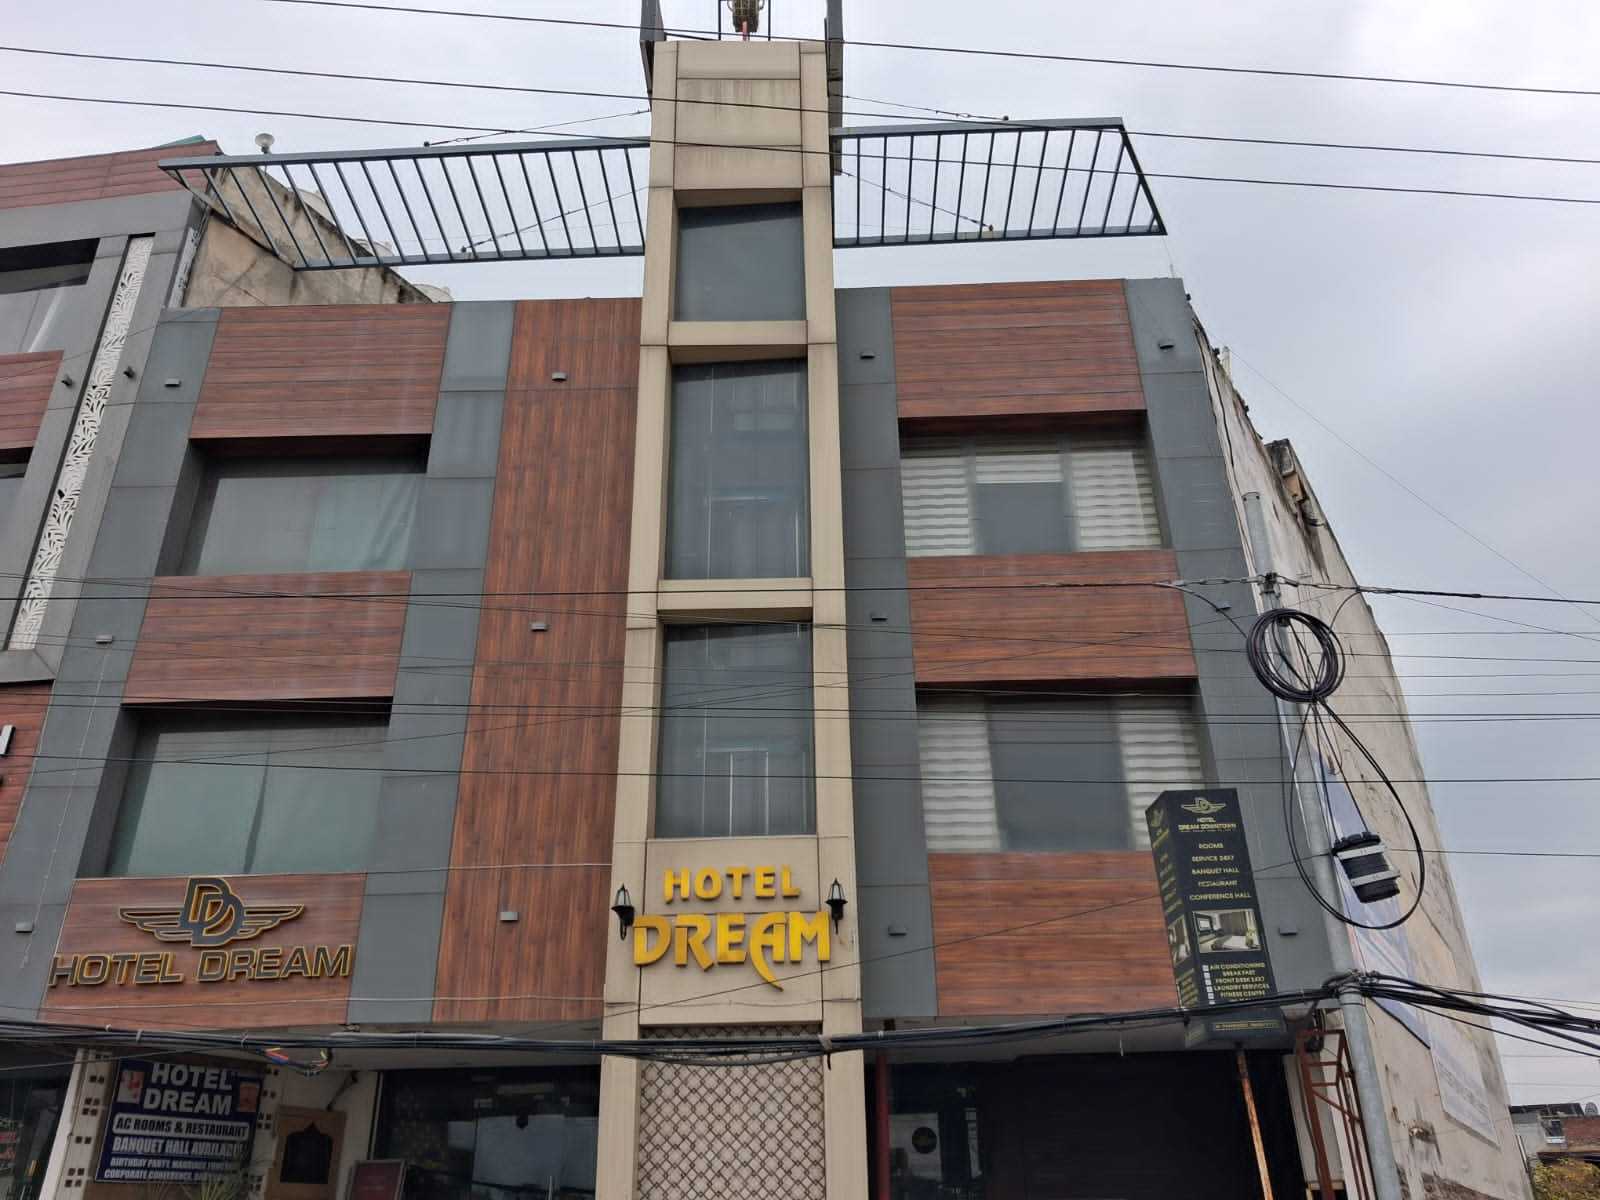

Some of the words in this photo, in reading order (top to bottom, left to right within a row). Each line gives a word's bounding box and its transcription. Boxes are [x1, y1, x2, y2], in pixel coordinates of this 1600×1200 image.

[663, 864, 801, 904] HOTEL
[48, 951, 184, 986] HOTEL
[196, 944, 354, 982] DREAM
[632, 911, 831, 992] DREAM
[151, 1062, 233, 1091] HOTEL
[143, 1087, 233, 1115] DREAM
[116, 1117, 132, 1130] AC
[133, 1118, 173, 1133] ROOMS
[174, 1121, 184, 1134] &
[185, 1121, 248, 1138] RESTAURANT
[112, 1136, 165, 1154] BANQUET
[165, 1138, 190, 1155] HALL
